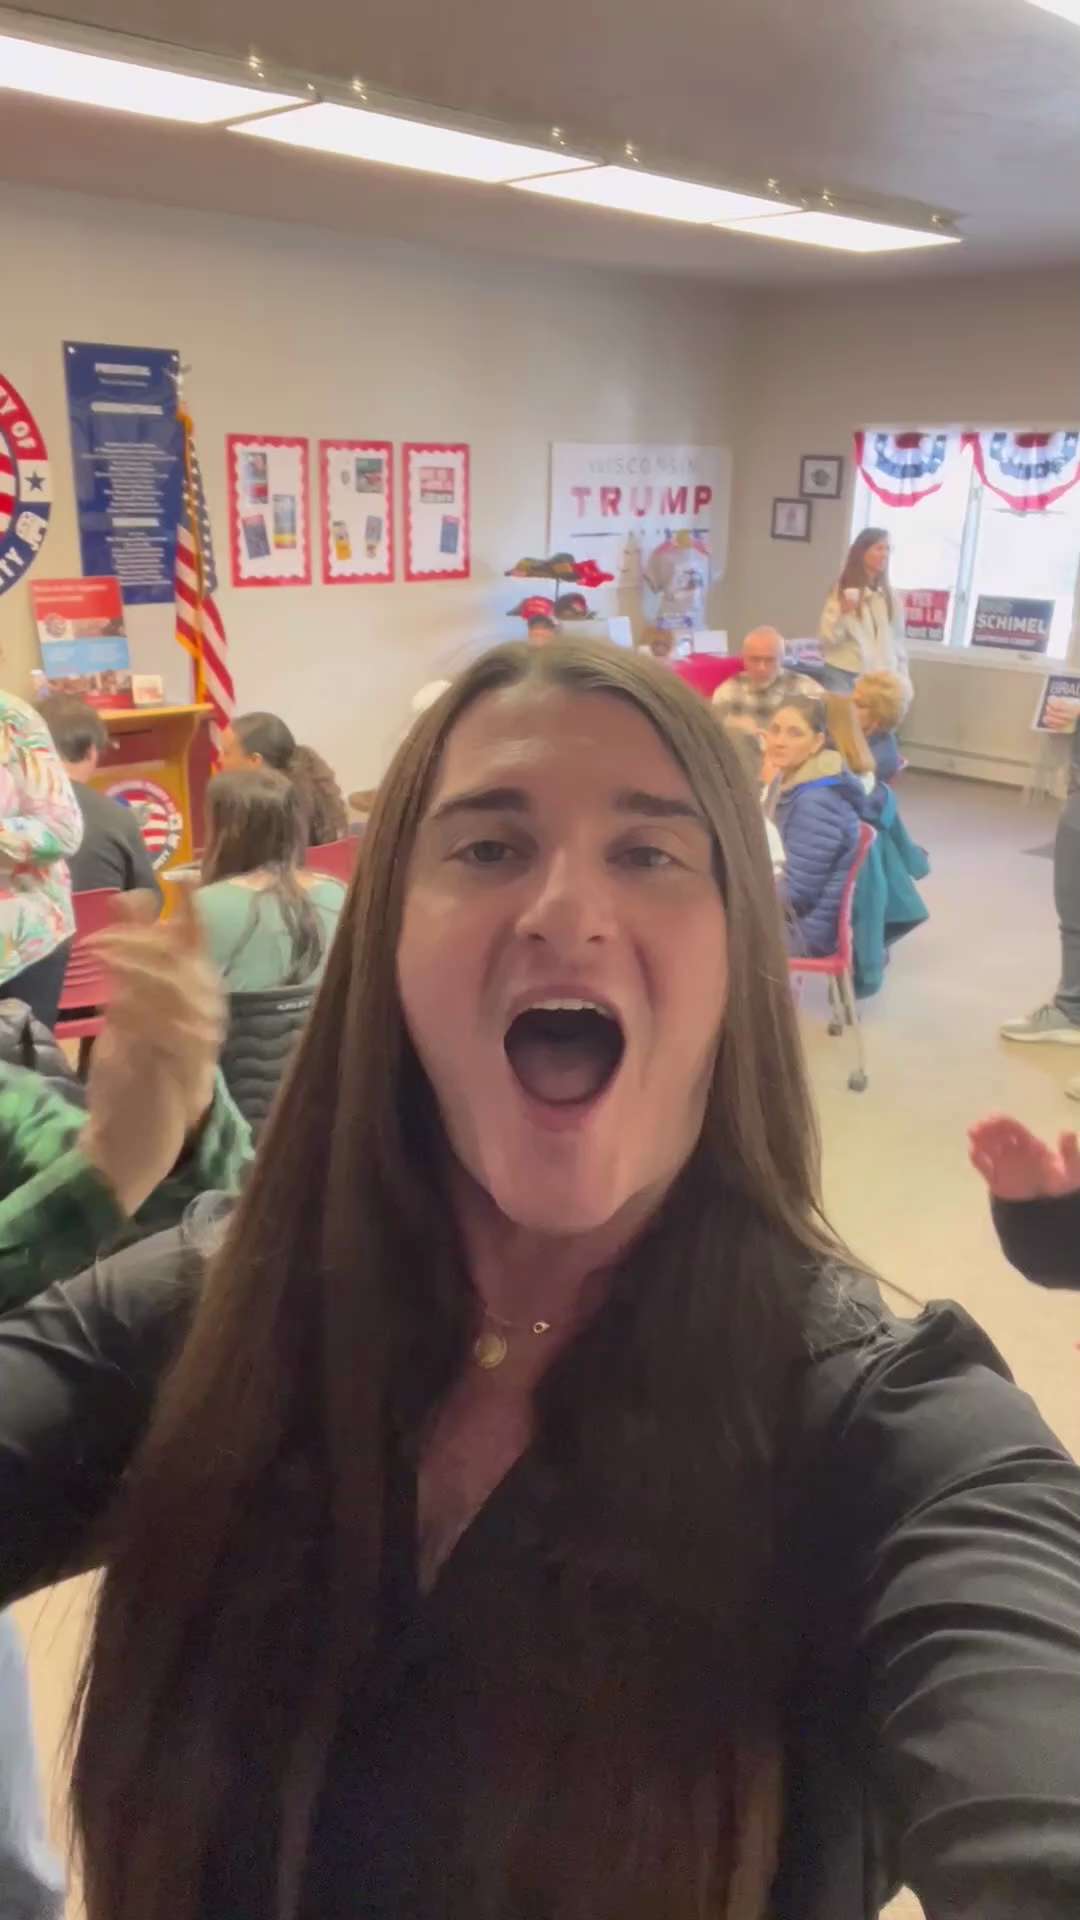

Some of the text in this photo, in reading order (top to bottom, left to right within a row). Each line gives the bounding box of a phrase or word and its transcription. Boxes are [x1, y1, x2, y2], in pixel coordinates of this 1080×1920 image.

[11, 420, 37, 449] OF
[569, 484, 713, 518] TRUMP
[975, 613, 1048, 635] SCHIMEL
